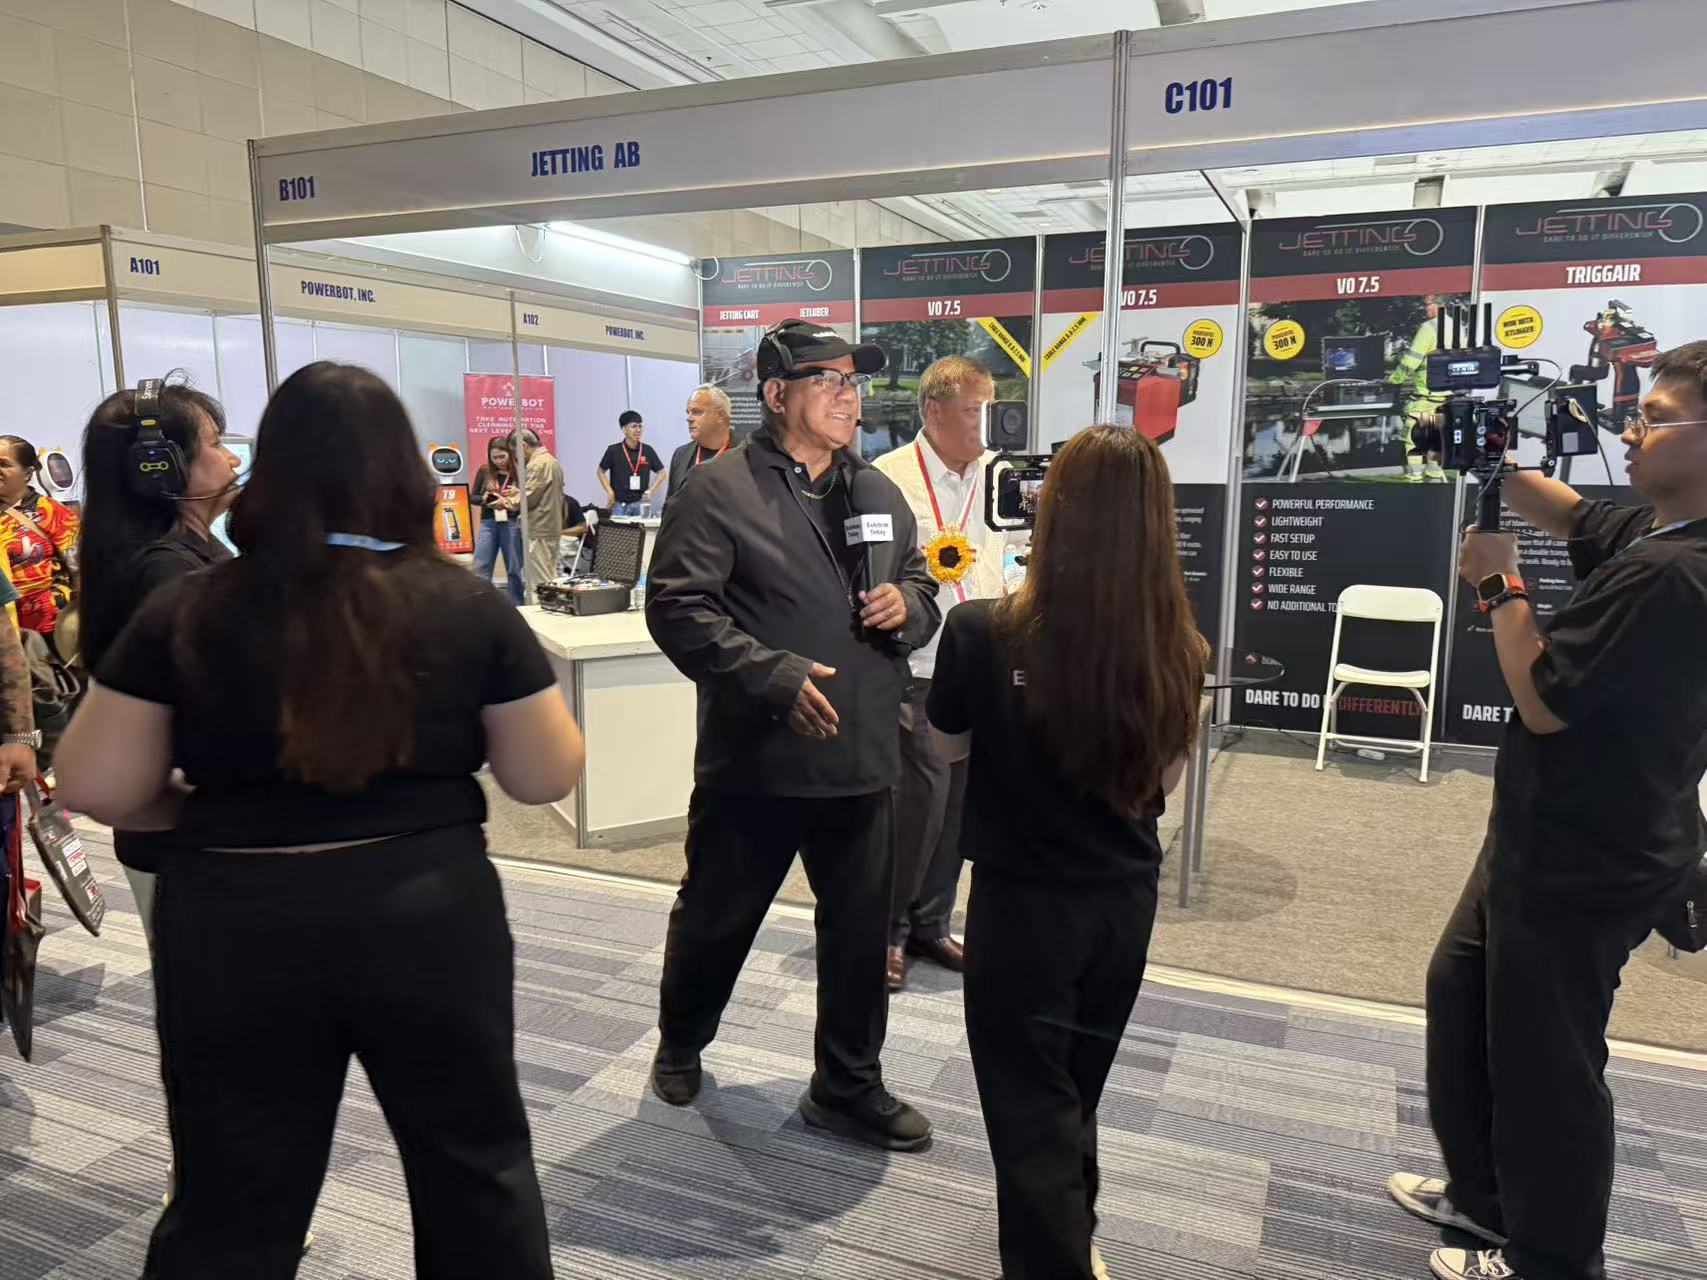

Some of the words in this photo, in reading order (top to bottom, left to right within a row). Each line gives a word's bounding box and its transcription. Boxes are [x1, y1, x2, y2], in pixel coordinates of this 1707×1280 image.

[1165, 77, 1232, 114] C101
[531, 145, 604, 177] JETTING
[614, 141, 640, 168] AB
[279, 176, 315, 201] B101
[1515, 210, 1673, 236] JETTING
[1278, 226, 1417, 250] JETTING
[1068, 241, 1191, 264] JETING
[130, 257, 160, 275] A101
[883, 255, 991, 276] JETTING
[720, 264, 816, 284] JETTING
[1566, 264, 1641, 284] TRIGGAIR
[1337, 278, 1355, 294] VO
[1358, 276, 1380, 293] 7.5
[358, 288, 376, 303] INC.
[1138, 289, 1158, 305] 7.5
[719, 311, 743, 320] JETTING
[743, 309, 760, 320] CART
[928, 301, 943, 316] VO
[943, 300, 961, 315] 7.5
[523, 313, 539, 326] A102
[1191, 336, 1206, 347] 300
[1207, 338, 1214, 348] N
[1272, 337, 1289, 350] 300
[1289, 335, 1297, 346] N
[481, 396, 544, 408] POWEBOT
[1272, 499, 1314, 509] POWERFUL
[1315, 499, 1374, 510] PERFORMANCE
[1271, 516, 1324, 527] LIGHTWEIGHT
[1270, 533, 1289, 543] FAST
[1289, 534, 1315, 544] SETUP
[1269, 550, 1290, 560] EASY
[1290, 551, 1301, 561] TO
[1302, 551, 1318, 561] USE
[1268, 567, 1304, 577] FLEXIBLE
[1267, 584, 1288, 594] WIDE
[1289, 584, 1317, 595] RANGE
[1267, 601, 1279, 610] NO
[1280, 601, 1327, 612] ADDITIONAL
[1245, 689, 1280, 706] DARE
[1281, 691, 1299, 708] TO
[1301, 693, 1320, 709] DO
[1463, 704, 1501, 722] DARE
